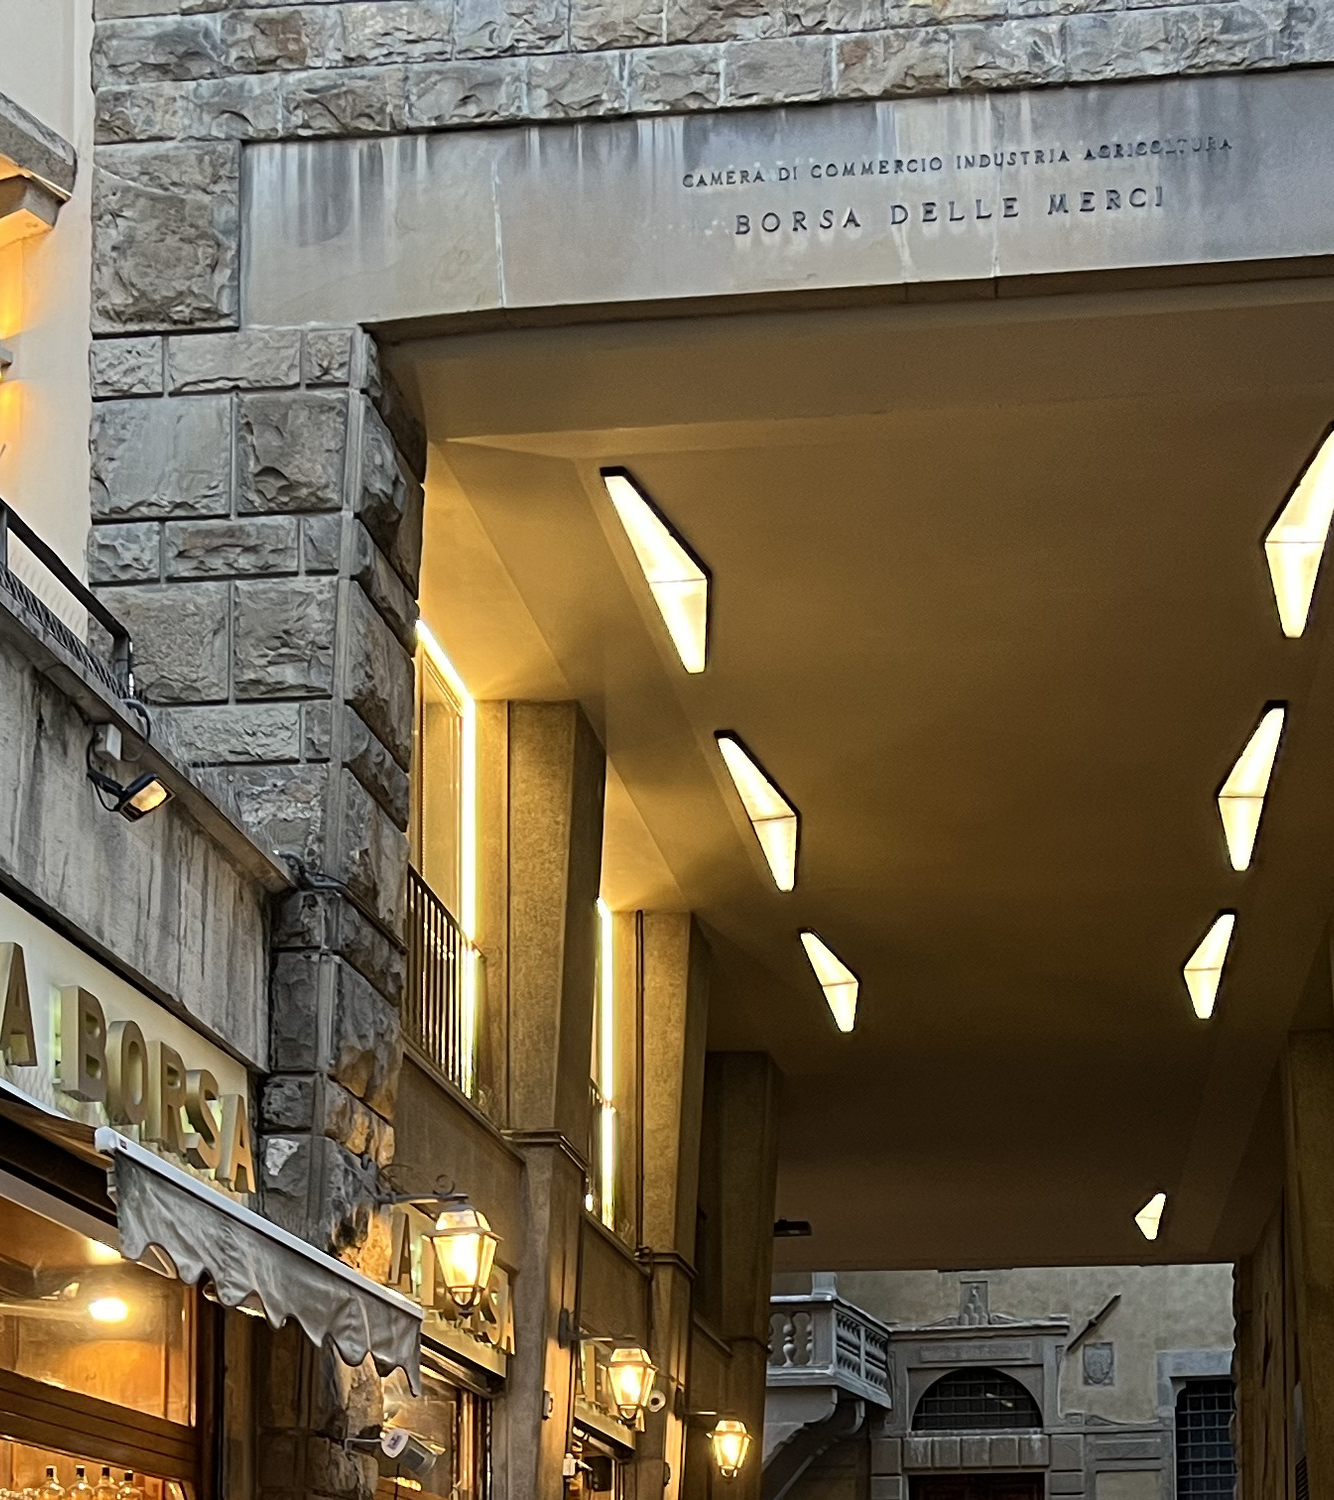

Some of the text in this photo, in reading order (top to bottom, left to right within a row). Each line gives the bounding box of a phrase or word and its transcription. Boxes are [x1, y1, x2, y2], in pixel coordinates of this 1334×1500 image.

[682, 169, 765, 188] CAMERA
[778, 166, 798, 182] DI
[810, 156, 943, 179] COMMERCIO
[956, 148, 1071, 170] INDUSTRIA
[735, 186, 1163, 235] BORSA DELLE MERCI
[61, 985, 256, 1194] BORSA
